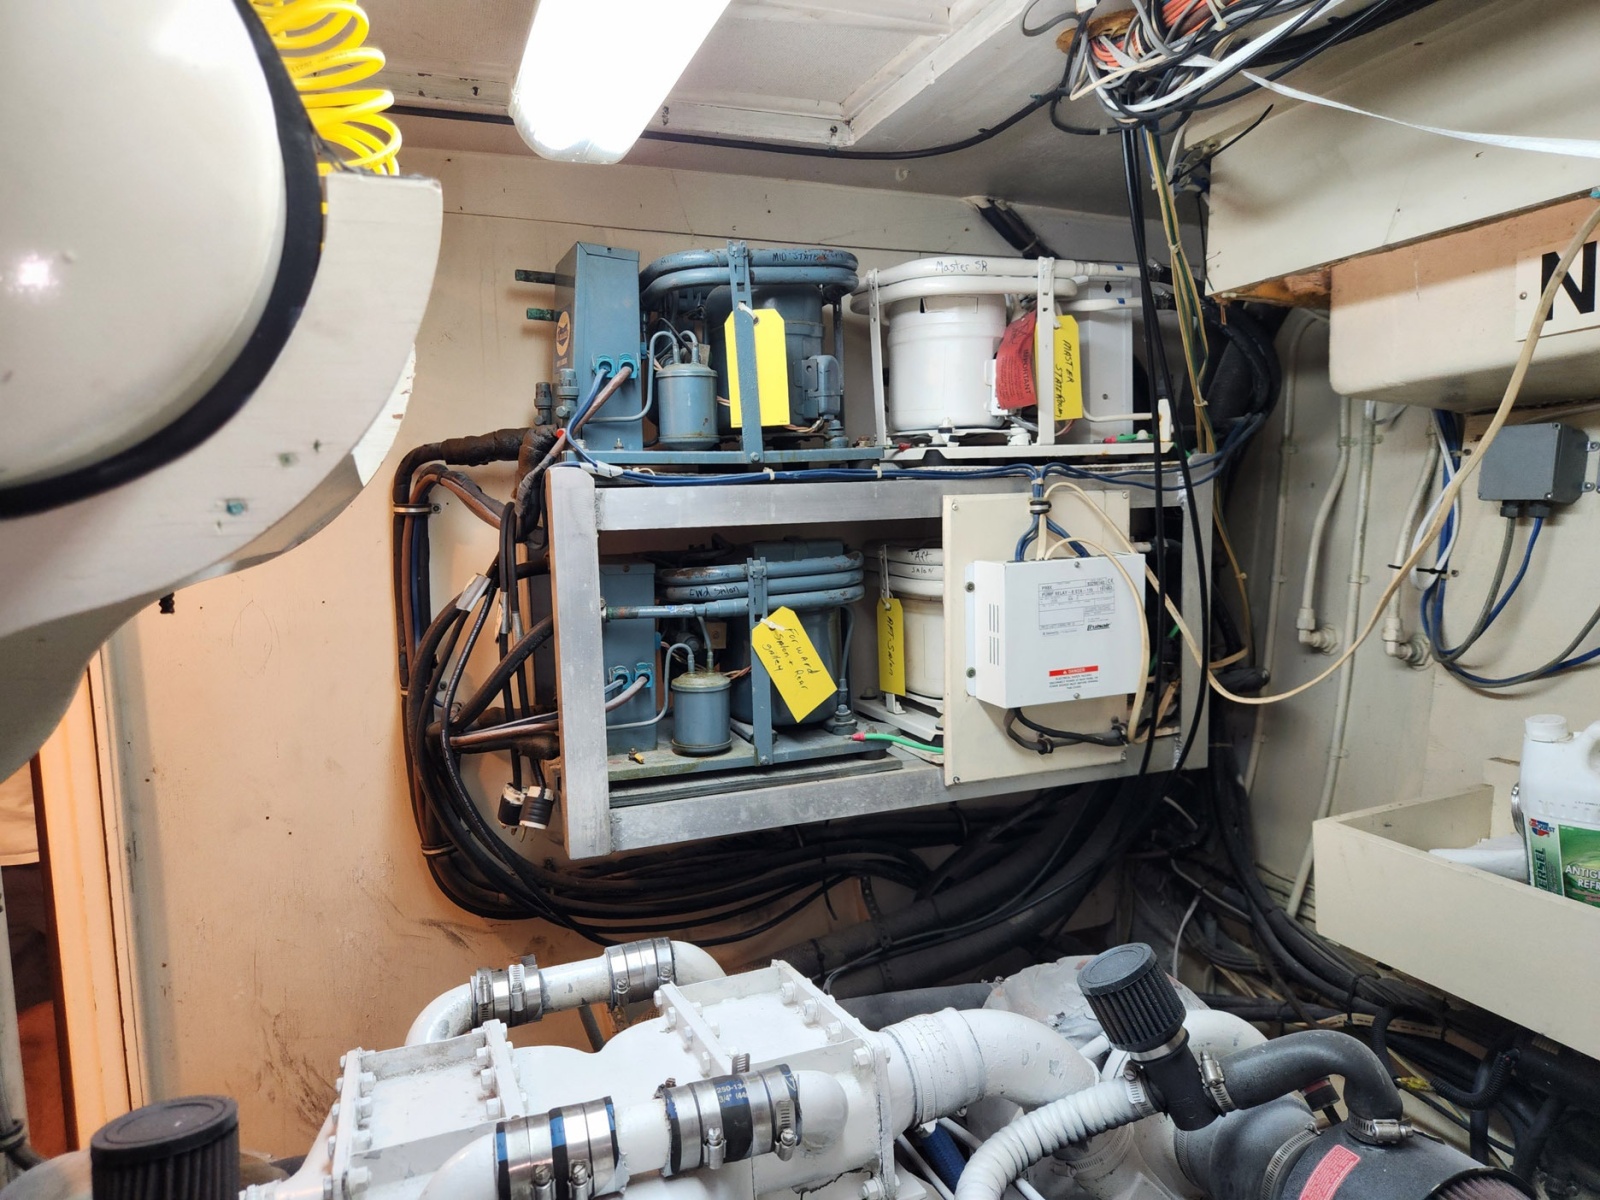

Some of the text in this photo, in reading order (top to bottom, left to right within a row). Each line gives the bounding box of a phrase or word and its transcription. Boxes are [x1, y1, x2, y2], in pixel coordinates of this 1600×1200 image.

[935, 259, 988, 273] Master SR
[1540, 240, 1597, 321] N
[1022, 349, 1032, 394] IMPORTANT
[1063, 339, 1075, 383] MASTER
[1565, 864, 1600, 880] ANTIG
[716, 1083, 745, 1094] 250-13
